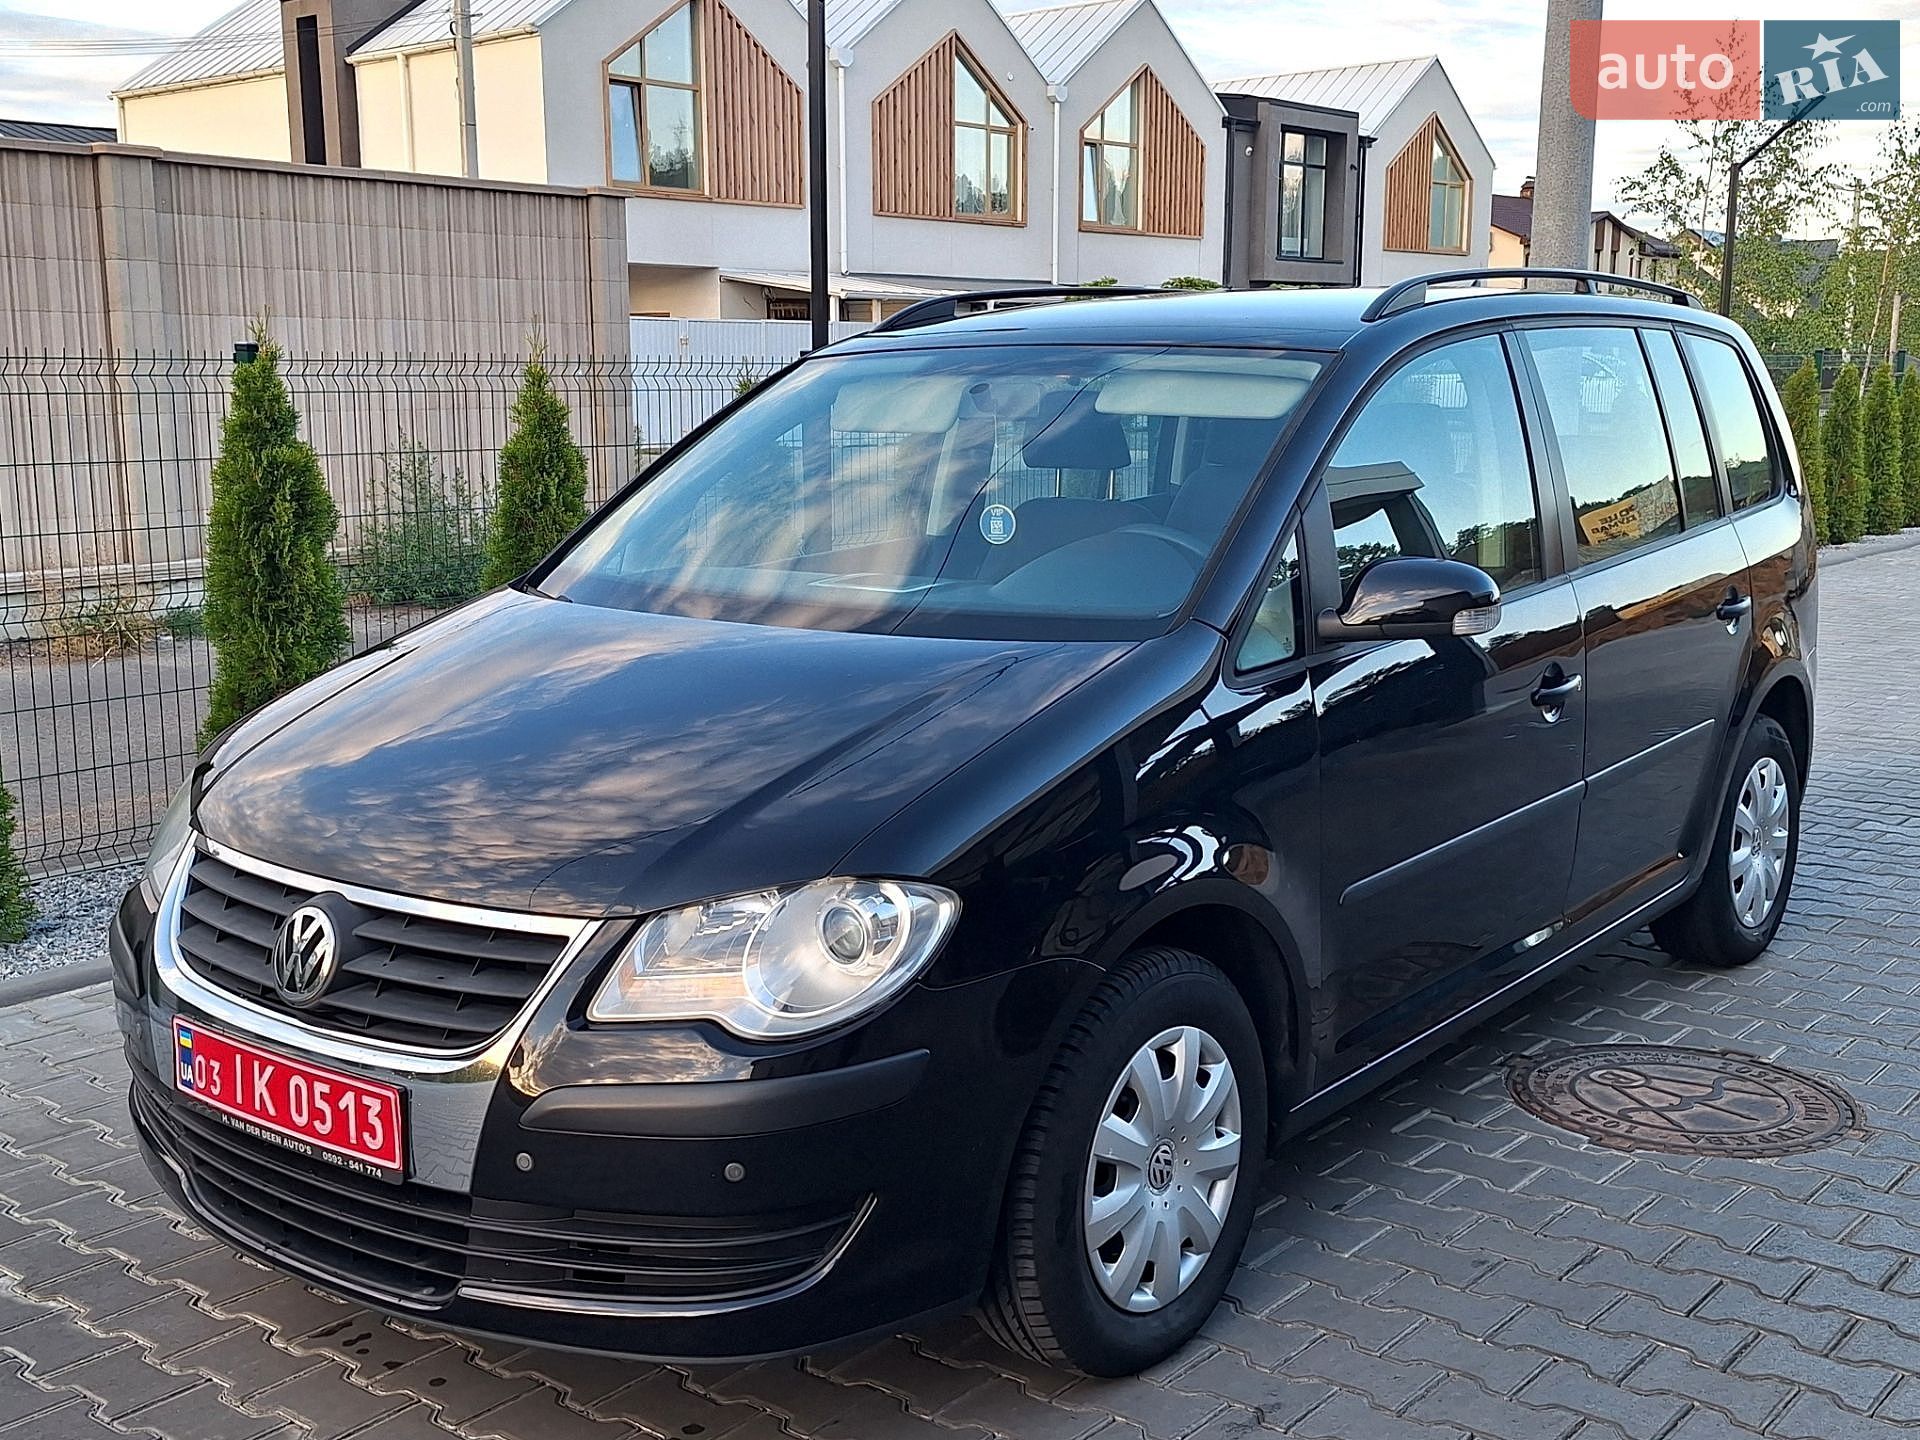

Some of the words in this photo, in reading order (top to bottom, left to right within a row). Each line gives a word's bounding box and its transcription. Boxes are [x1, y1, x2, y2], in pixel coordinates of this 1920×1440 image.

[990, 508, 1004, 516] VIP
[180, 1062, 194, 1084] UA
[195, 1054, 222, 1096] 03
[235, 1053, 277, 1117] IK
[289, 1074, 385, 1150] 0513
[230, 1117, 245, 1131] VAN
[246, 1123, 261, 1137] DER
[283, 1137, 312, 1155] AUTO'S
[322, 1151, 343, 1166] 0592
[365, 1165, 382, 1178] 774
